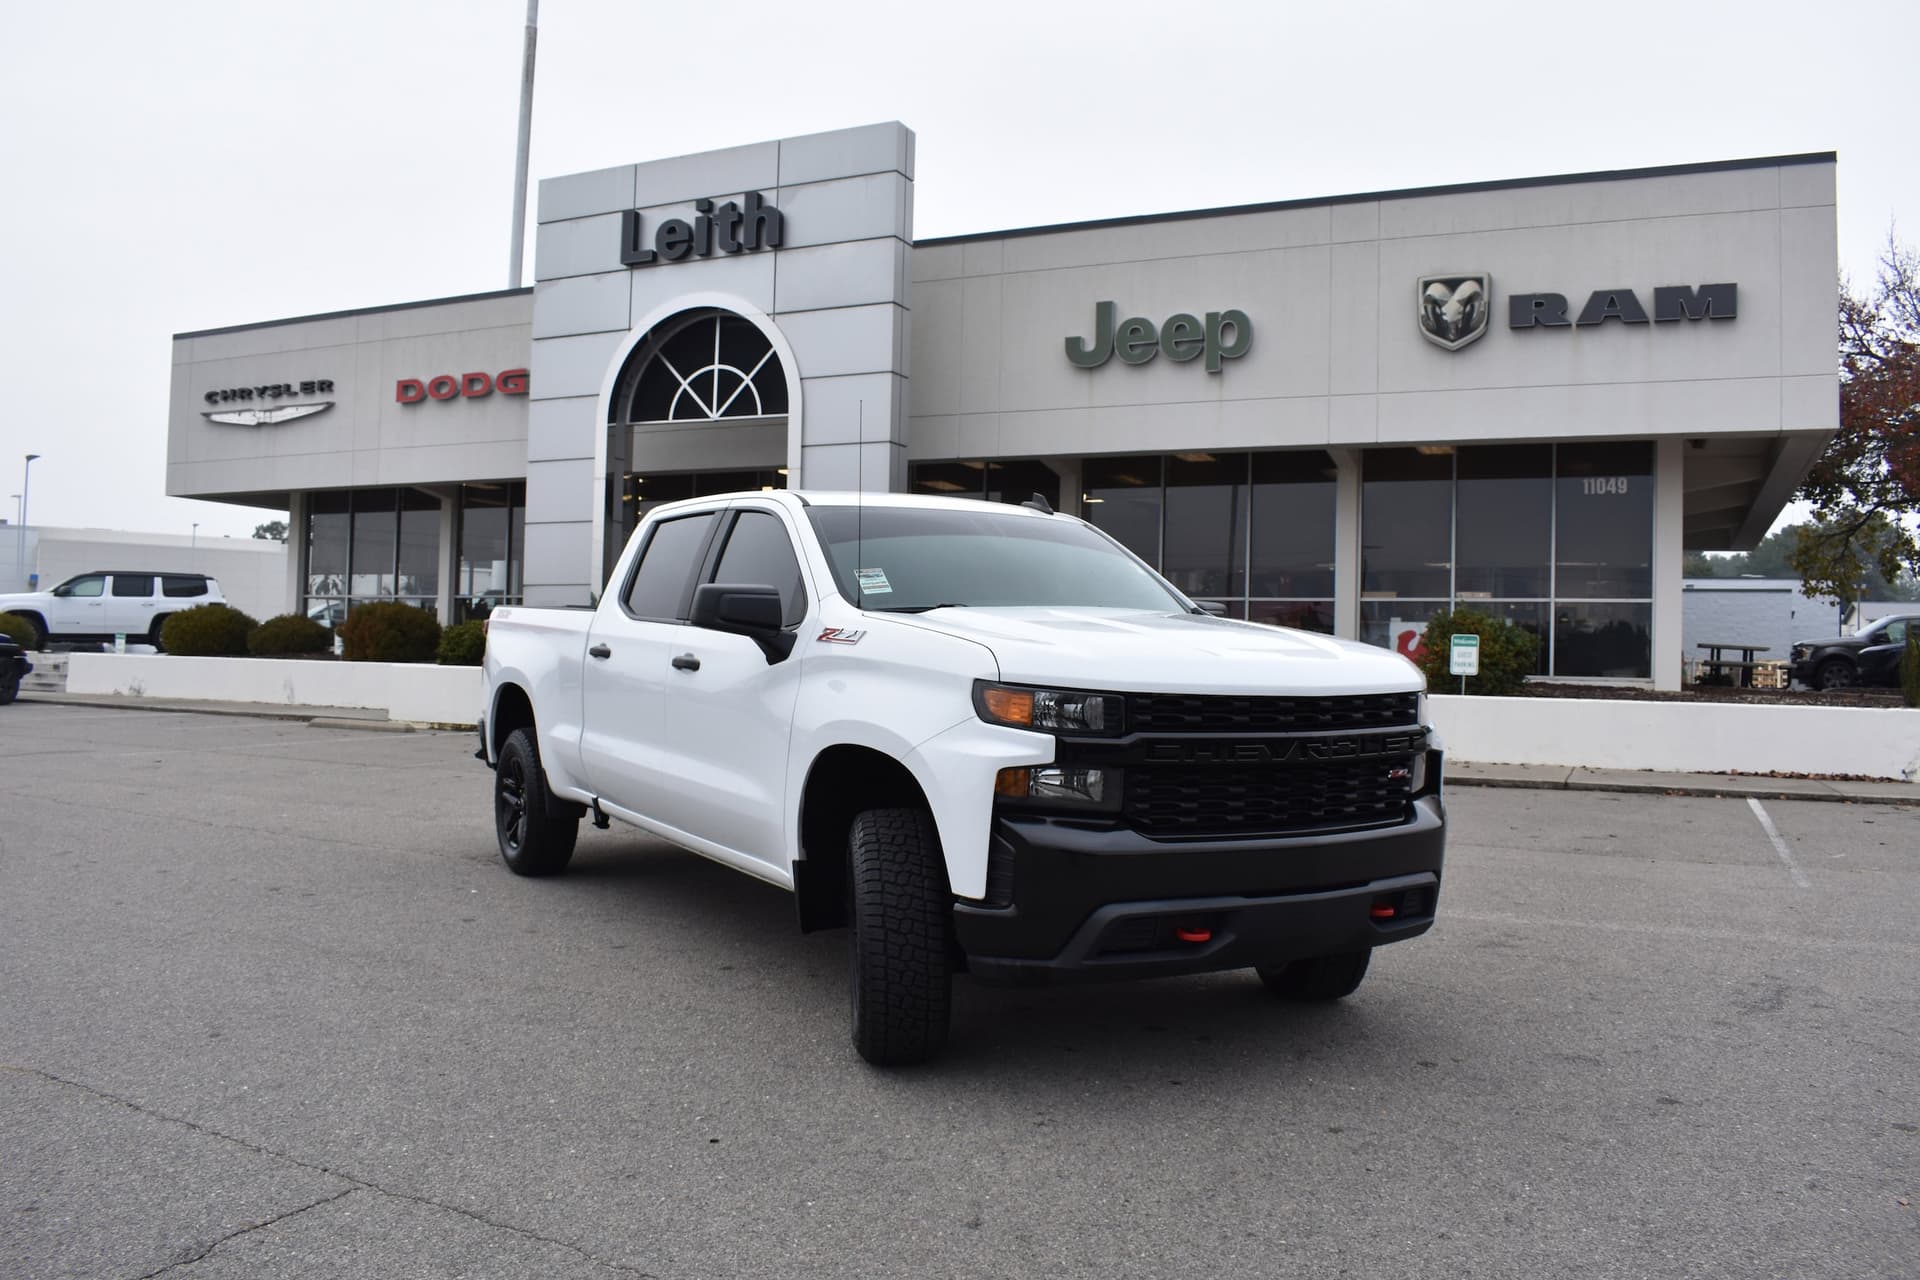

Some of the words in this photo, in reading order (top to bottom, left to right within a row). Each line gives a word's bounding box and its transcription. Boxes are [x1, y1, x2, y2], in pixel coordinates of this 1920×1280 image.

[620, 190, 785, 266] Leith
[1509, 282, 1738, 329] RAM
[1065, 300, 1254, 374] Jeep
[205, 379, 335, 405] CHRYSLER
[1583, 476, 1628, 496] 11049
[1143, 733, 1423, 764] CHEVROLET
